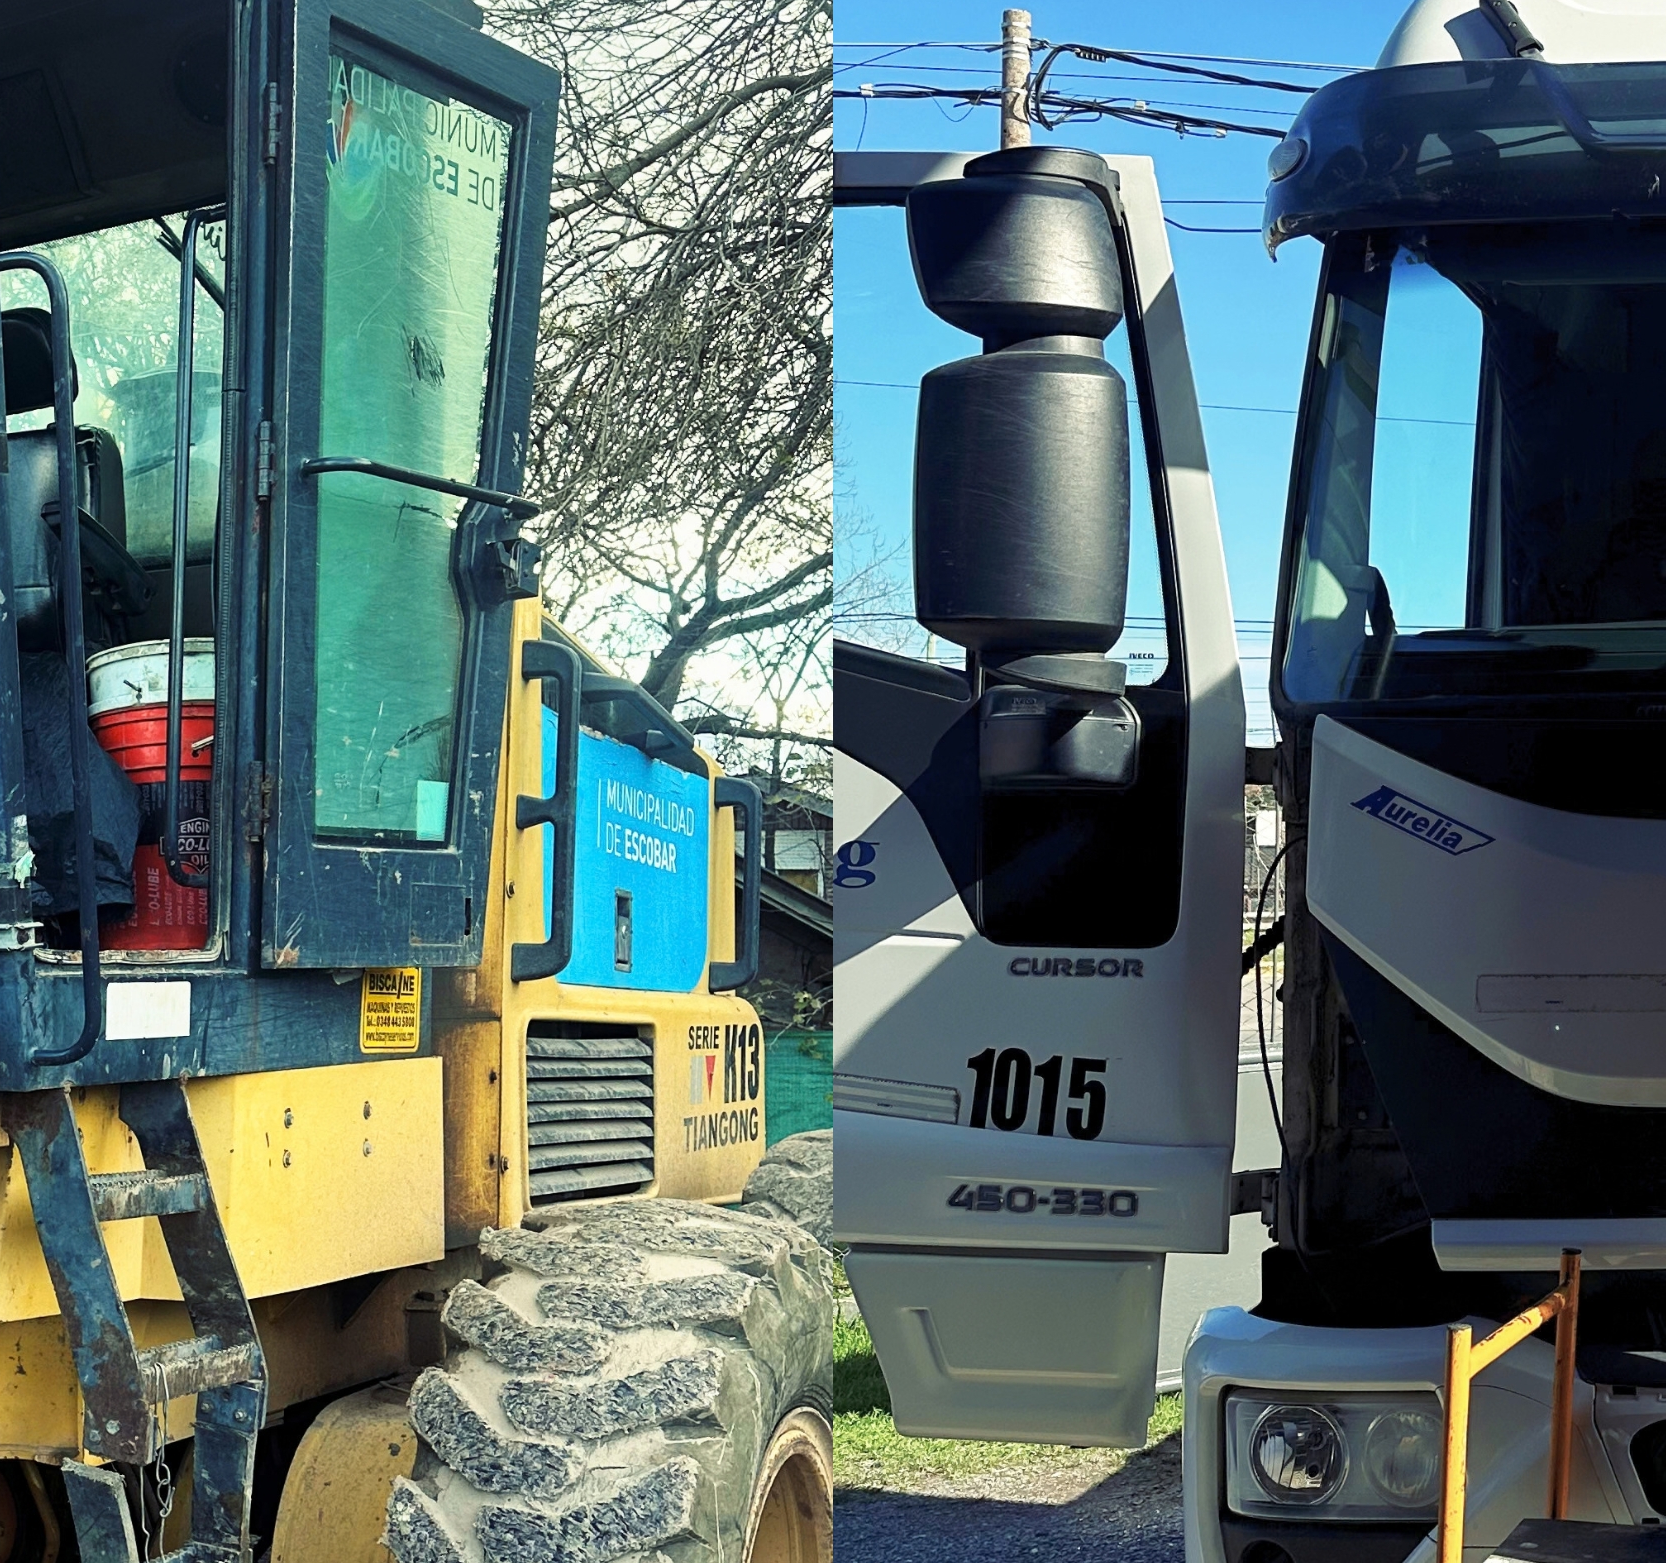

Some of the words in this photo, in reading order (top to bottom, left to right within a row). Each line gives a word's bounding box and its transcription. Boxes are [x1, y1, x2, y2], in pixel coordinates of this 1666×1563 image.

[606, 778, 695, 837] MUNICIPALIDAD
[1350, 785, 1463, 849] Aurelia
[178, 838, 209, 851] CO-L
[191, 854, 209, 866] OIL
[606, 822, 622, 857] DE
[624, 828, 677, 874] ESCOBAR
[198, 889, 208, 925] ECO-LUB
[1008, 957, 1144, 978] CURSOR
[688, 1026, 720, 1050] SERIE
[724, 1023, 760, 1103] K13
[966, 1047, 1107, 1141] 1015
[683, 1107, 759, 1153] TIANGONG
[946, 1184, 1139, 1217] 450-330
